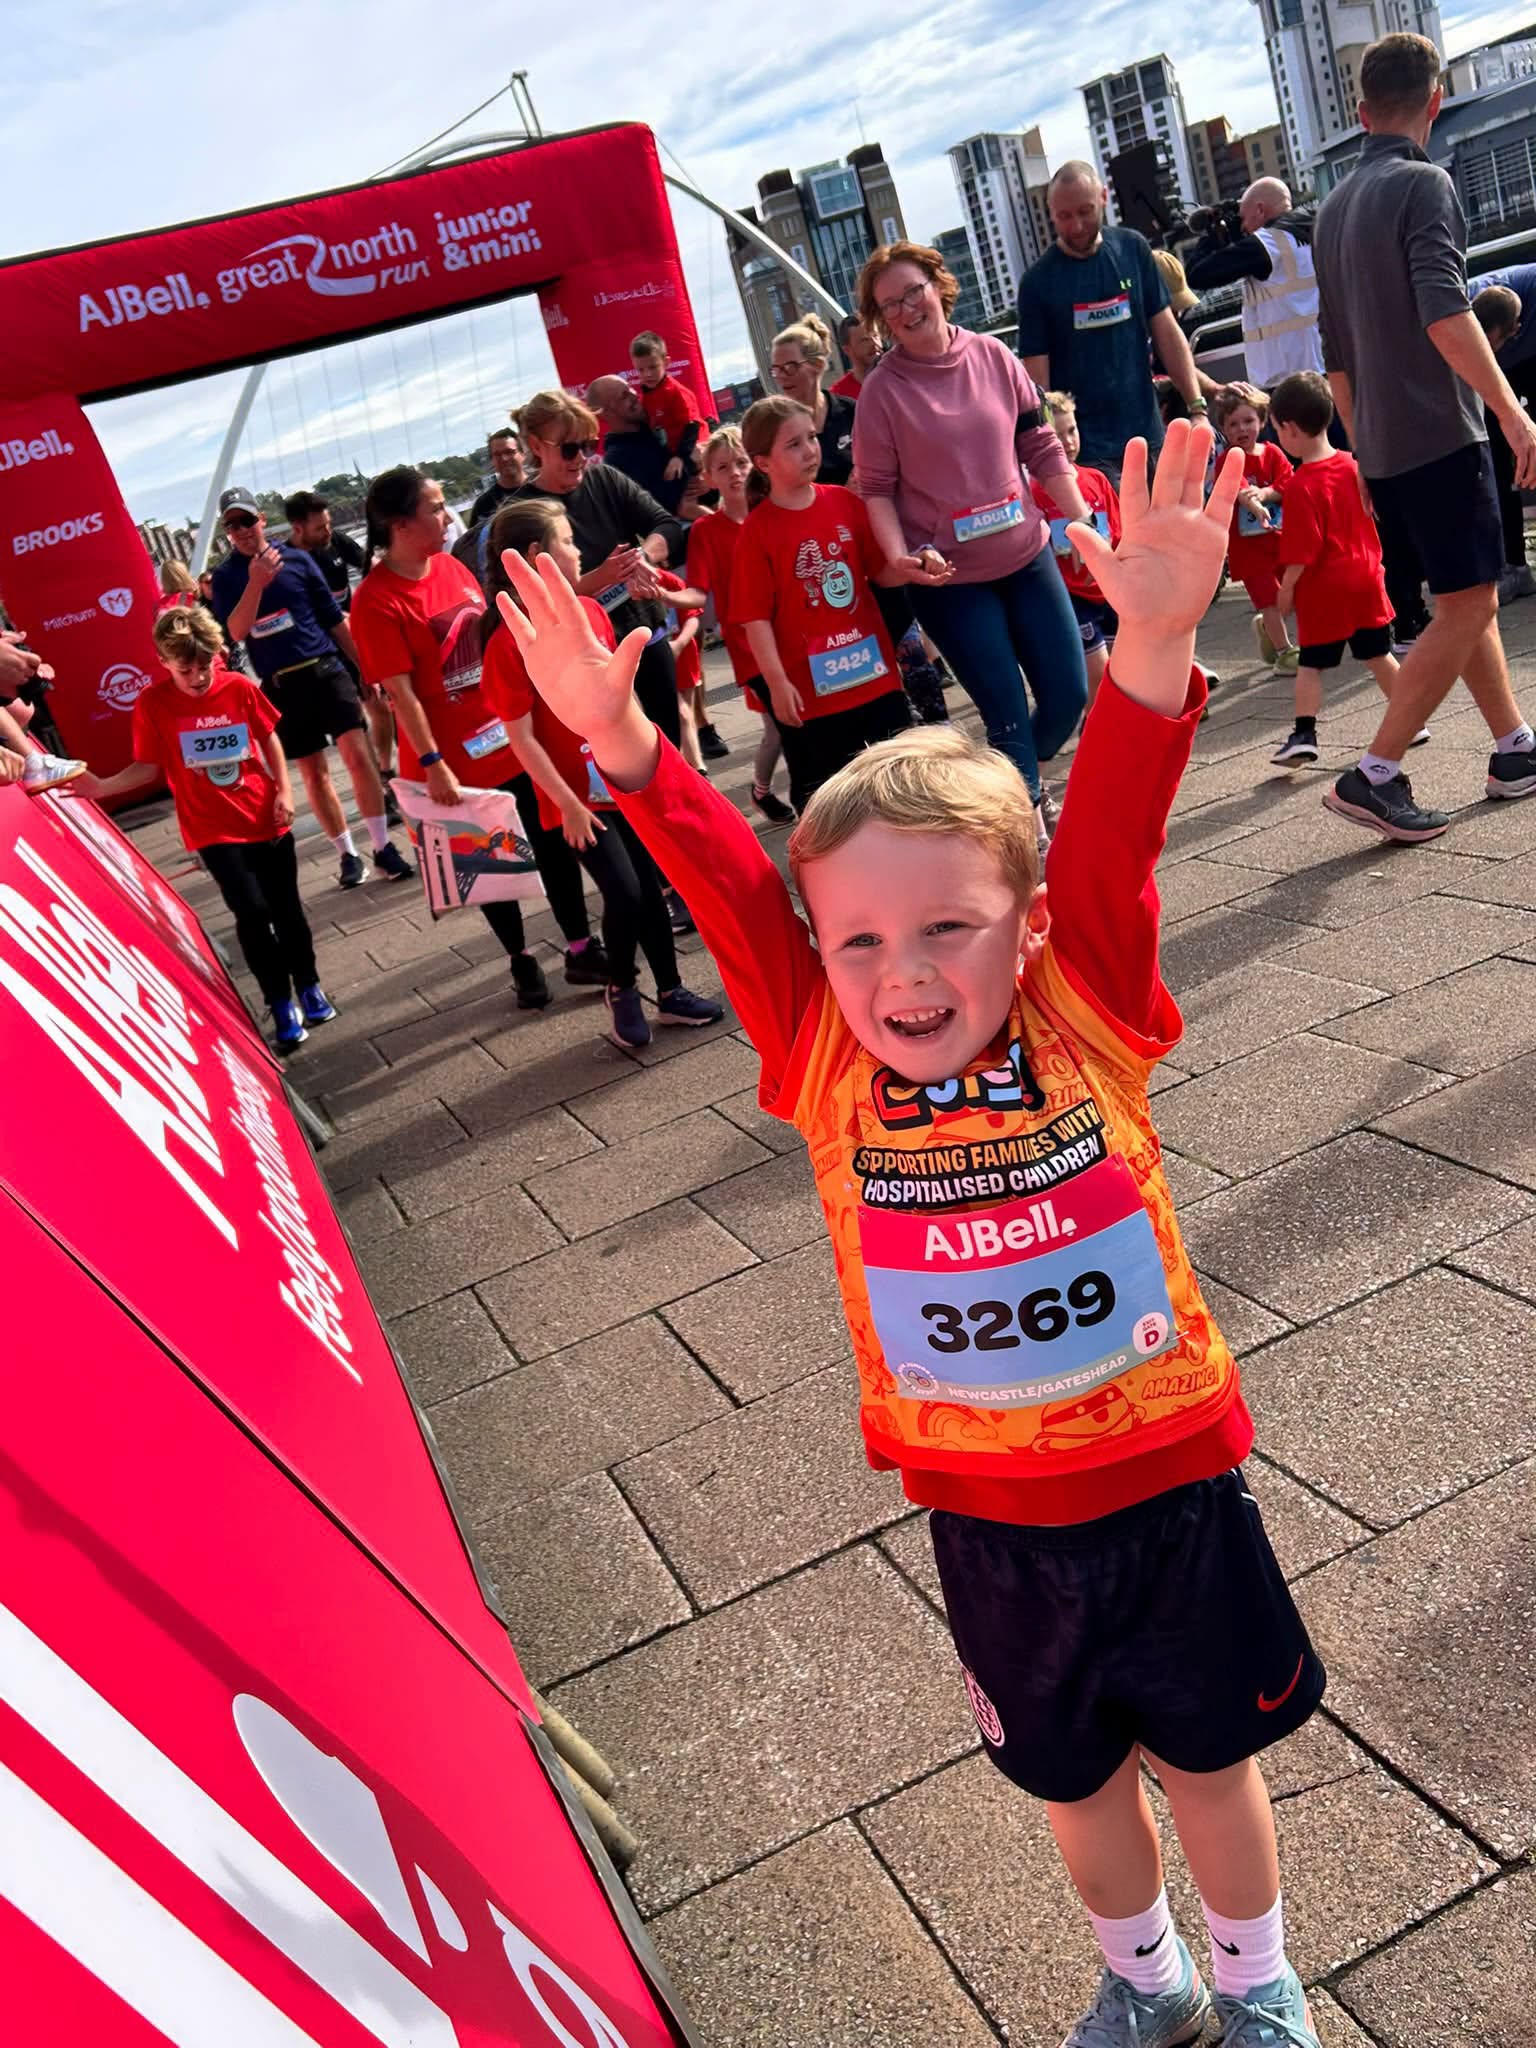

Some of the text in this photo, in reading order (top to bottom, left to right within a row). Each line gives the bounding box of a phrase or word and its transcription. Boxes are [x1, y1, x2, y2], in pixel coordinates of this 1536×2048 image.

[433, 200, 533, 244] junior
[442, 228, 543, 272] &mini
[79, 222, 417, 333] AJBell great north
[379, 259, 430, 288] run
[1088, 305, 1119, 320] ADULT
[0, 429, 63, 471] JBell
[12, 512, 105, 556] BROOKS
[972, 506, 1010, 528] ADULT
[827, 629, 859, 648] AJBell
[824, 647, 871, 677] 3424
[97, 675, 152, 701] SOLGAR
[196, 715, 228, 729] AJBell
[481, 728, 506, 747] ADU
[194, 733, 239, 752] 3738
[1051, 1102, 1101, 1142] WITH
[864, 1134, 1100, 1204] HOSPITALISED CHILDREN
[924, 1200, 1060, 1261] AJBell
[921, 1270, 1117, 1354] 3269
[1144, 1330, 1159, 1347] D
[948, 1354, 1128, 1400] NEWCASTLE/GATESHEAD
[1141, 1361, 1219, 1400] AMAZING!
